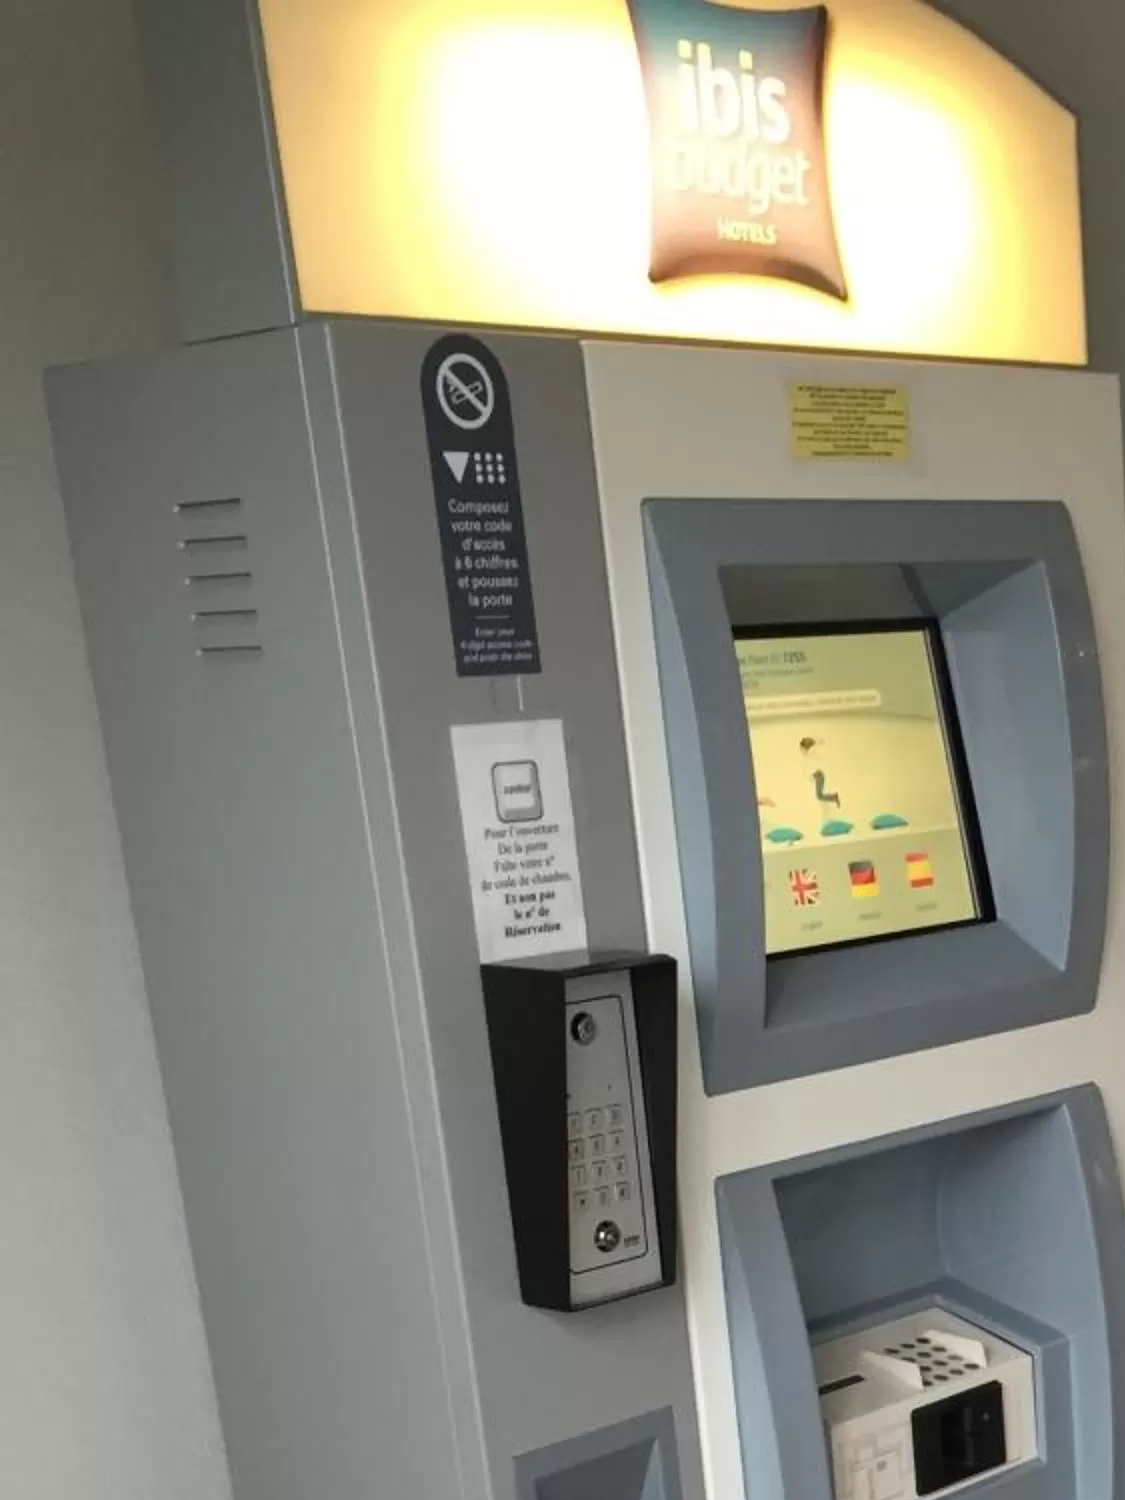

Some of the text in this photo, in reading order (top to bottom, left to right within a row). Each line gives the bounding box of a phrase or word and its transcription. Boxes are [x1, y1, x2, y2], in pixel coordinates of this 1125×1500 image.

[676, 39, 790, 145] ibis
[664, 148, 811, 215] budget
[717, 217, 777, 245] HOTELS
[447, 498, 509, 516] Composez
[451, 518, 512, 532] votre code
[458, 575, 469, 588] et
[467, 592, 512, 608] la porte
